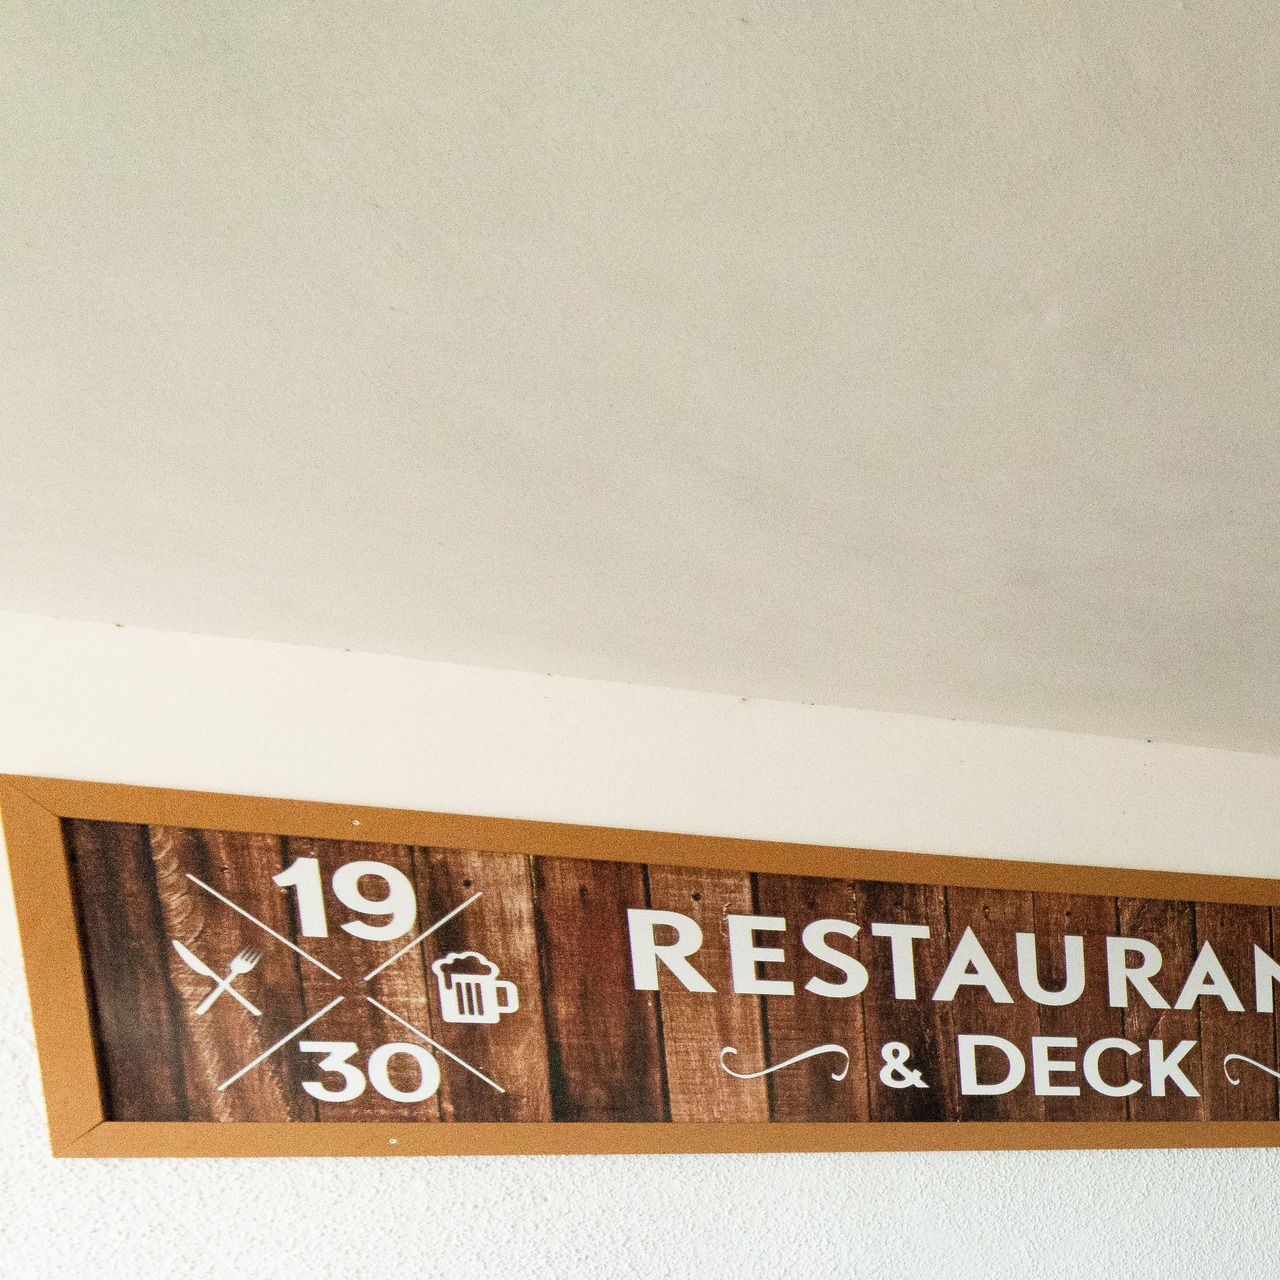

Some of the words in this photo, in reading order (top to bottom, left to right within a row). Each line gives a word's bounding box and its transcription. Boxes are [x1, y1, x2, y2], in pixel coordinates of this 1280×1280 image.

[272, 856, 418, 942] 19
[299, 1041, 441, 1103] 30
[880, 1041, 930, 1089] &
[957, 1034, 1201, 1097] DECK
